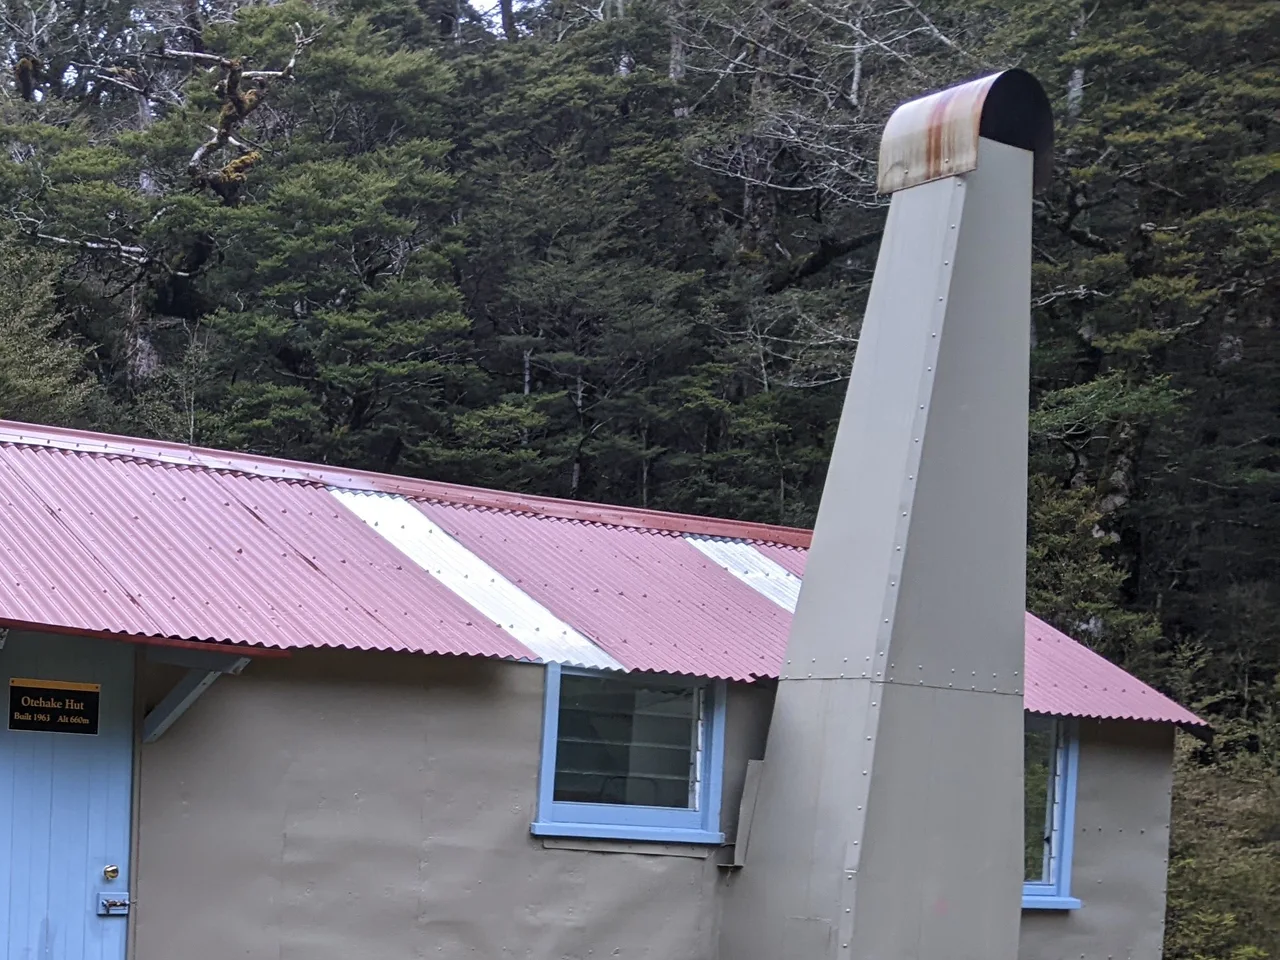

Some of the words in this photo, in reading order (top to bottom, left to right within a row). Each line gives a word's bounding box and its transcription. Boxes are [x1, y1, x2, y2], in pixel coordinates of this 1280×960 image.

[21, 696, 63, 709] Otehake
[65, 699, 84, 710] Hut
[14, 711, 32, 721] Built
[33, 713, 50, 722] 1963
[57, 715, 69, 723] Alt
[70, 716, 90, 724] 660m
